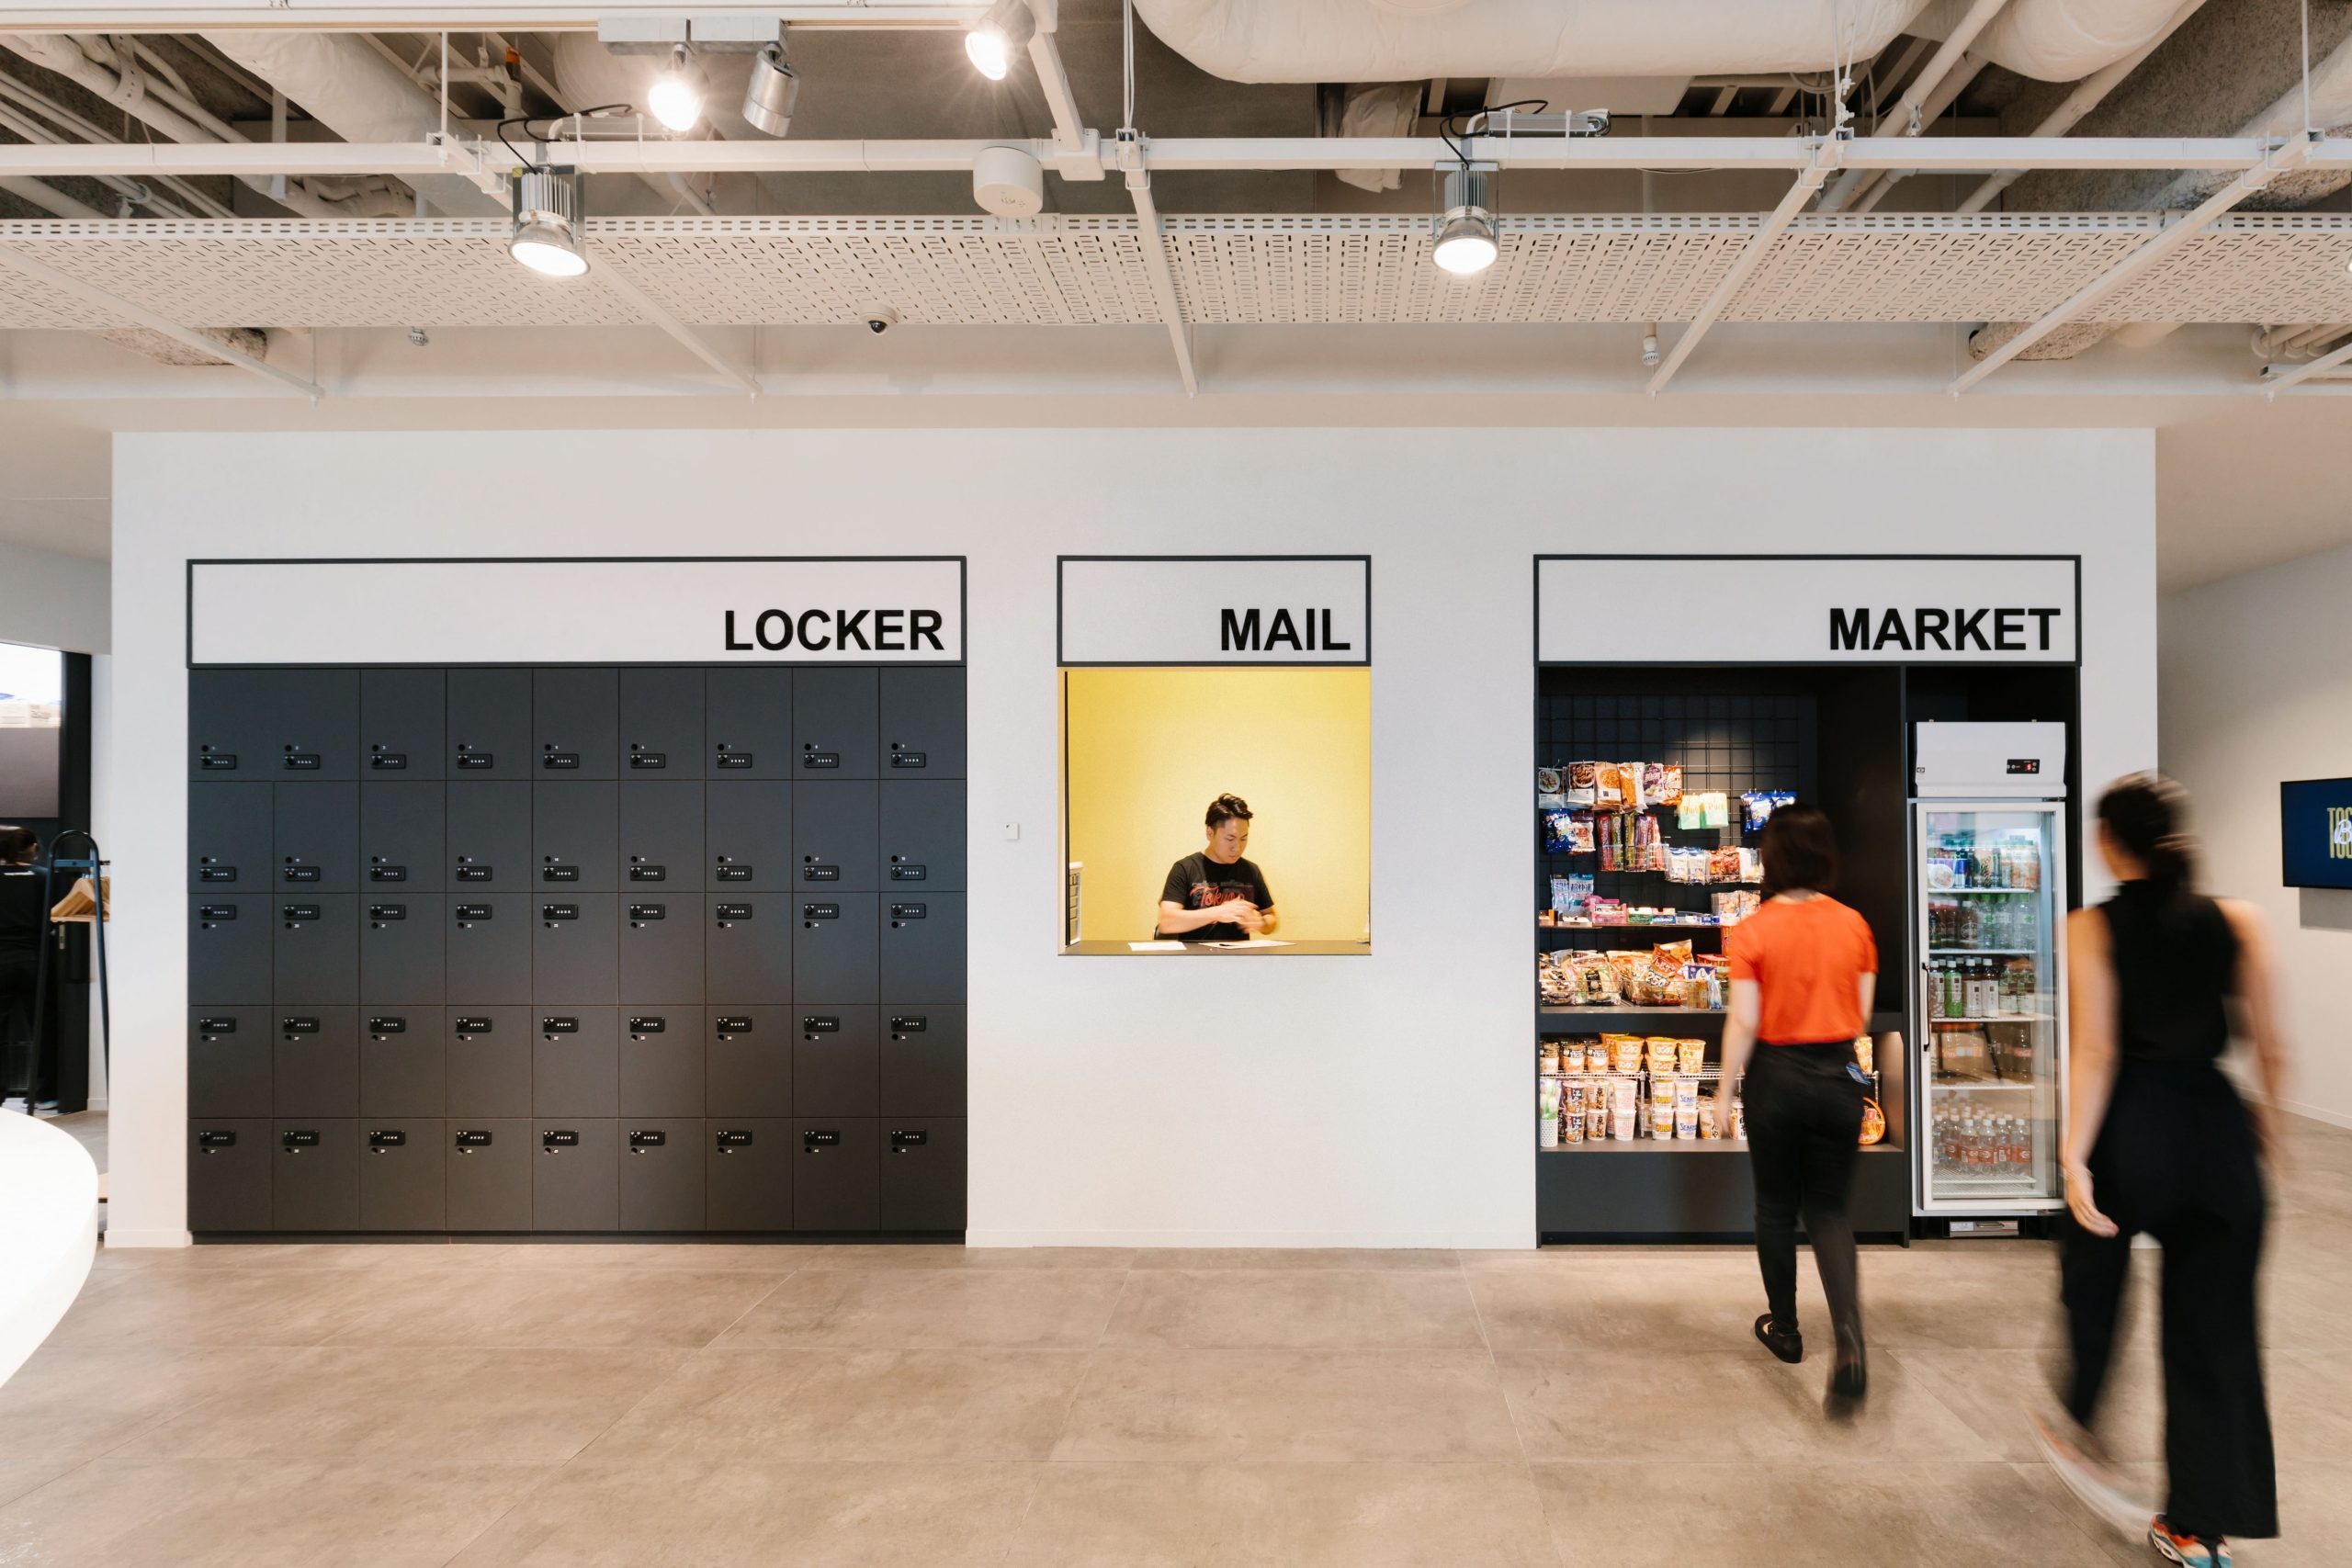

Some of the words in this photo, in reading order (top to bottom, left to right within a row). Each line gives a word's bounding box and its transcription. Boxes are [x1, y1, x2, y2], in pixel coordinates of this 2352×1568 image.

[725, 608, 944, 651] LOCKER
[1221, 608, 1351, 651] MAIL
[1829, 607, 2062, 651] MARKET
